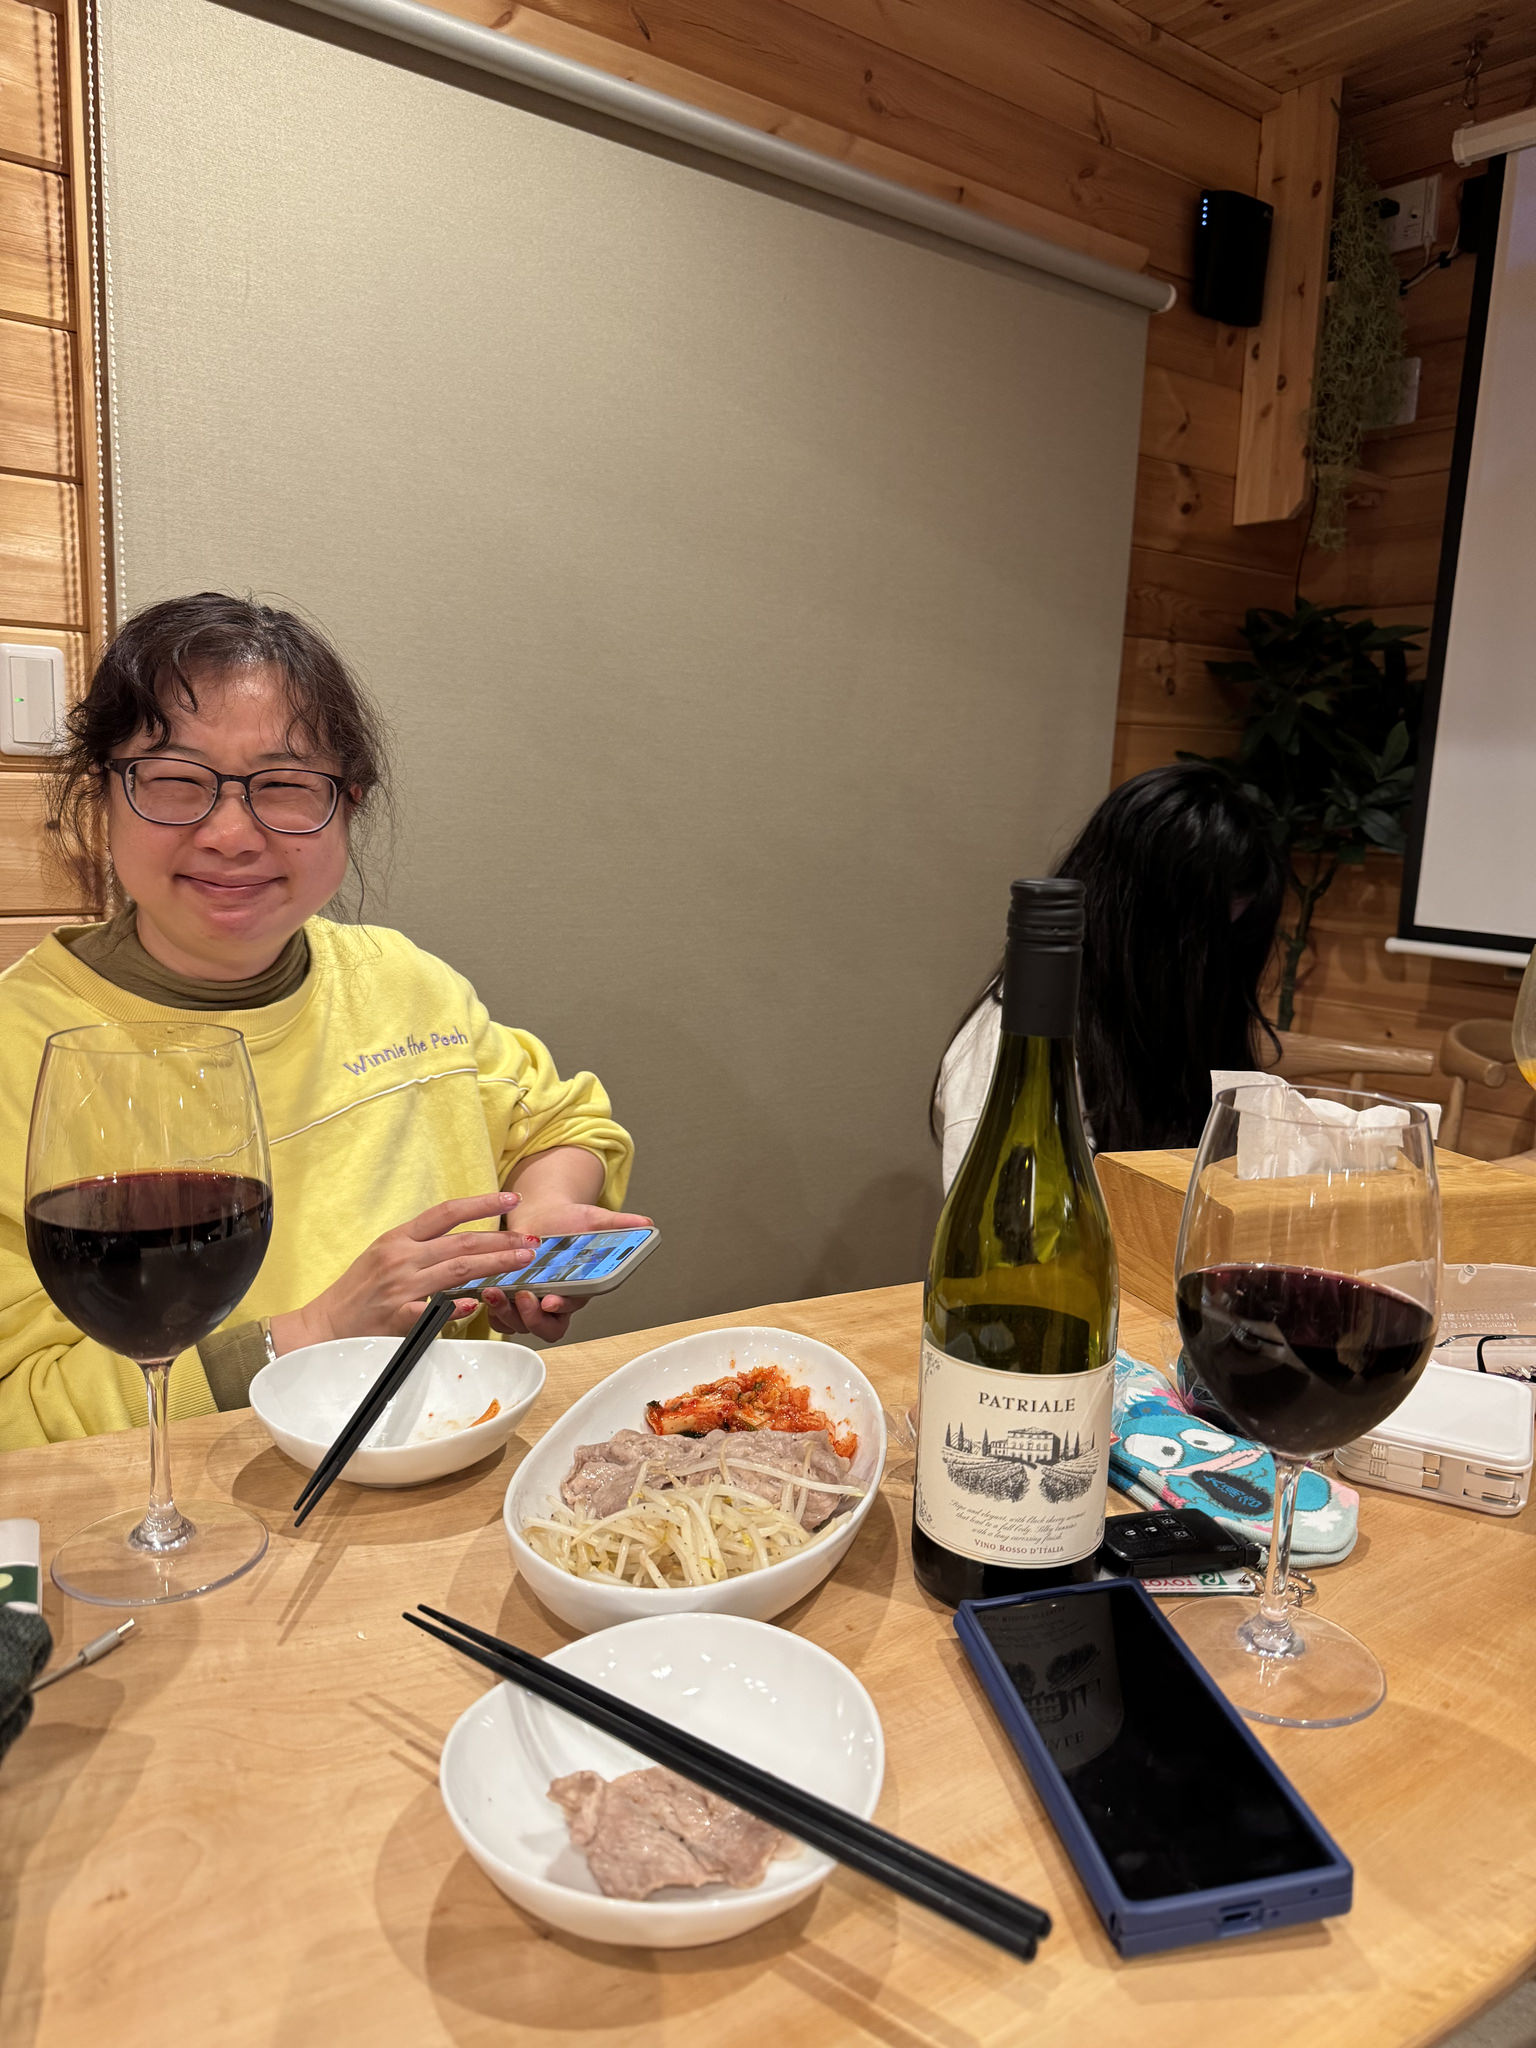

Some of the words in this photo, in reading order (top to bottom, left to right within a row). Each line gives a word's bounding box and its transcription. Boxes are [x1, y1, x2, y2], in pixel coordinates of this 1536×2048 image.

[343, 1043, 407, 1076] Winnie
[406, 1033, 428, 1057] the
[430, 1025, 469, 1049] Pooh
[979, 1391, 1076, 1412] PATRIALE
[974, 1538, 996, 1550] VINO
[999, 1544, 1027, 1554] ROSSO
[1030, 1546, 1064, 1555] D'ITALIA
[1140, 1578, 1197, 1587] TOYOT
